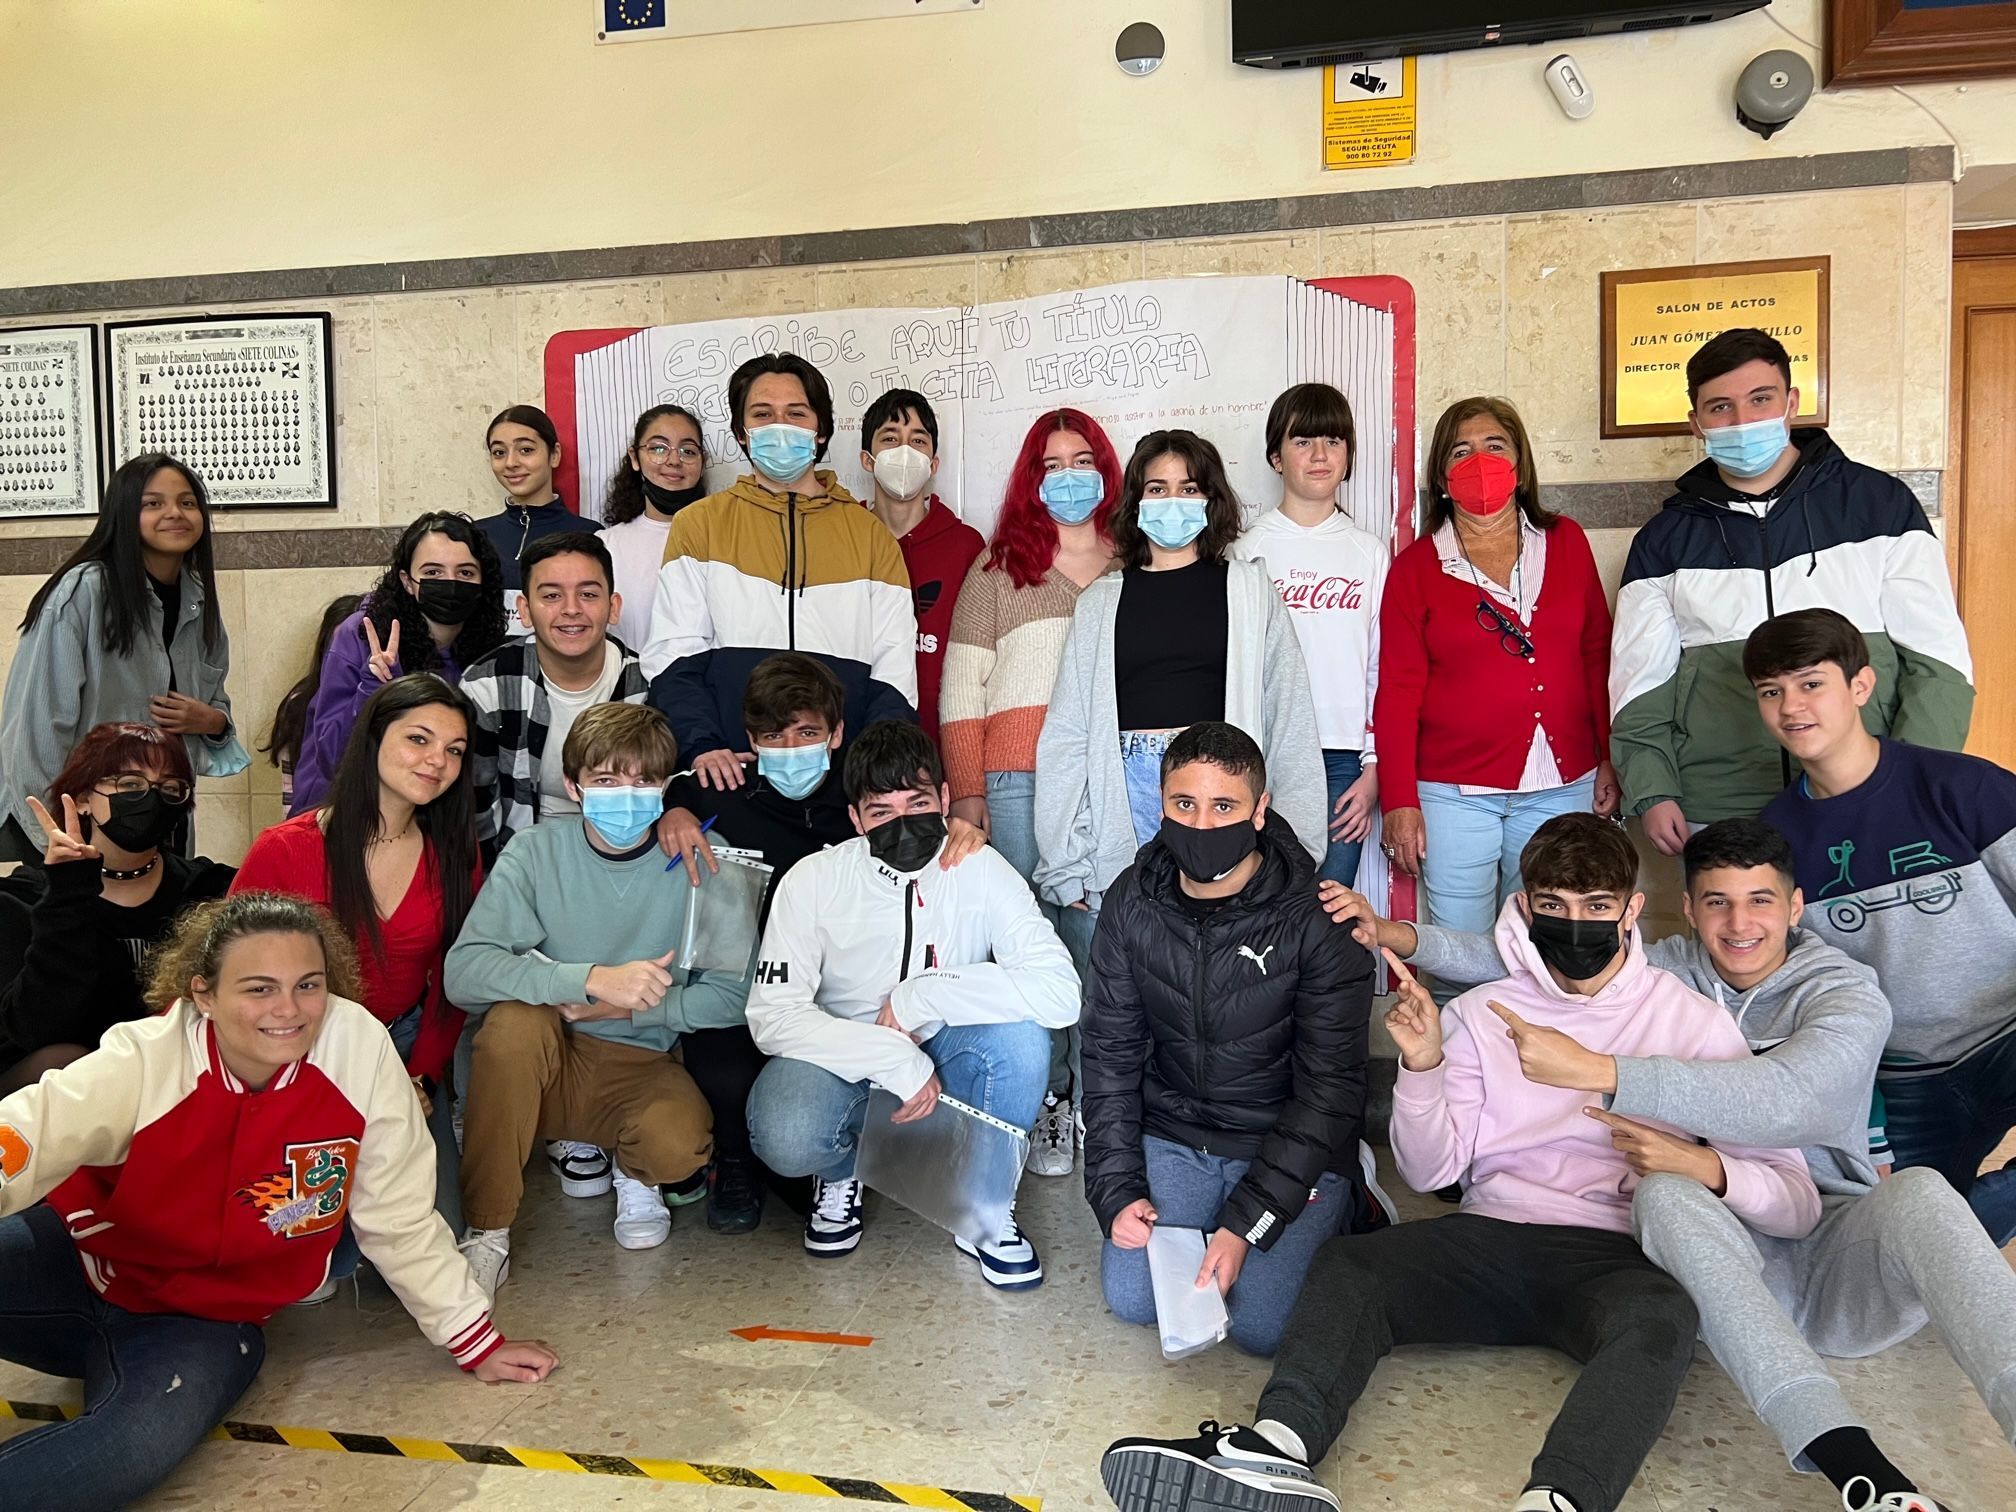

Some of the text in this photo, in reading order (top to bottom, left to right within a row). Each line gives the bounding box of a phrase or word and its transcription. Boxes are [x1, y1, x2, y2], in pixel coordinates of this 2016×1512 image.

[1375, 135, 1411, 144] Seguridad
[1656, 297, 1776, 314] SALON DE ACTOS
[890, 304, 979, 364] AQUÍ
[989, 309, 1031, 351] TU
[1043, 292, 1162, 343] TÍTULO
[1630, 333, 1668, 347] JUAN
[135, 352, 160, 365] Instituto
[161, 352, 168, 363] de
[170, 350, 201, 363] Enseñanza
[202, 349, 236, 362] Secundaria
[919, 360, 1004, 402] CITA
[1026, 333, 1211, 395] LITERARIA
[1624, 362, 1681, 373] DIRECTOR
[1290, 569, 1318, 580] Enjoy
[754, 960, 788, 984] HH
[1245, 1210, 1276, 1245] PUMA
[1265, 1465, 1288, 1475] AIR
